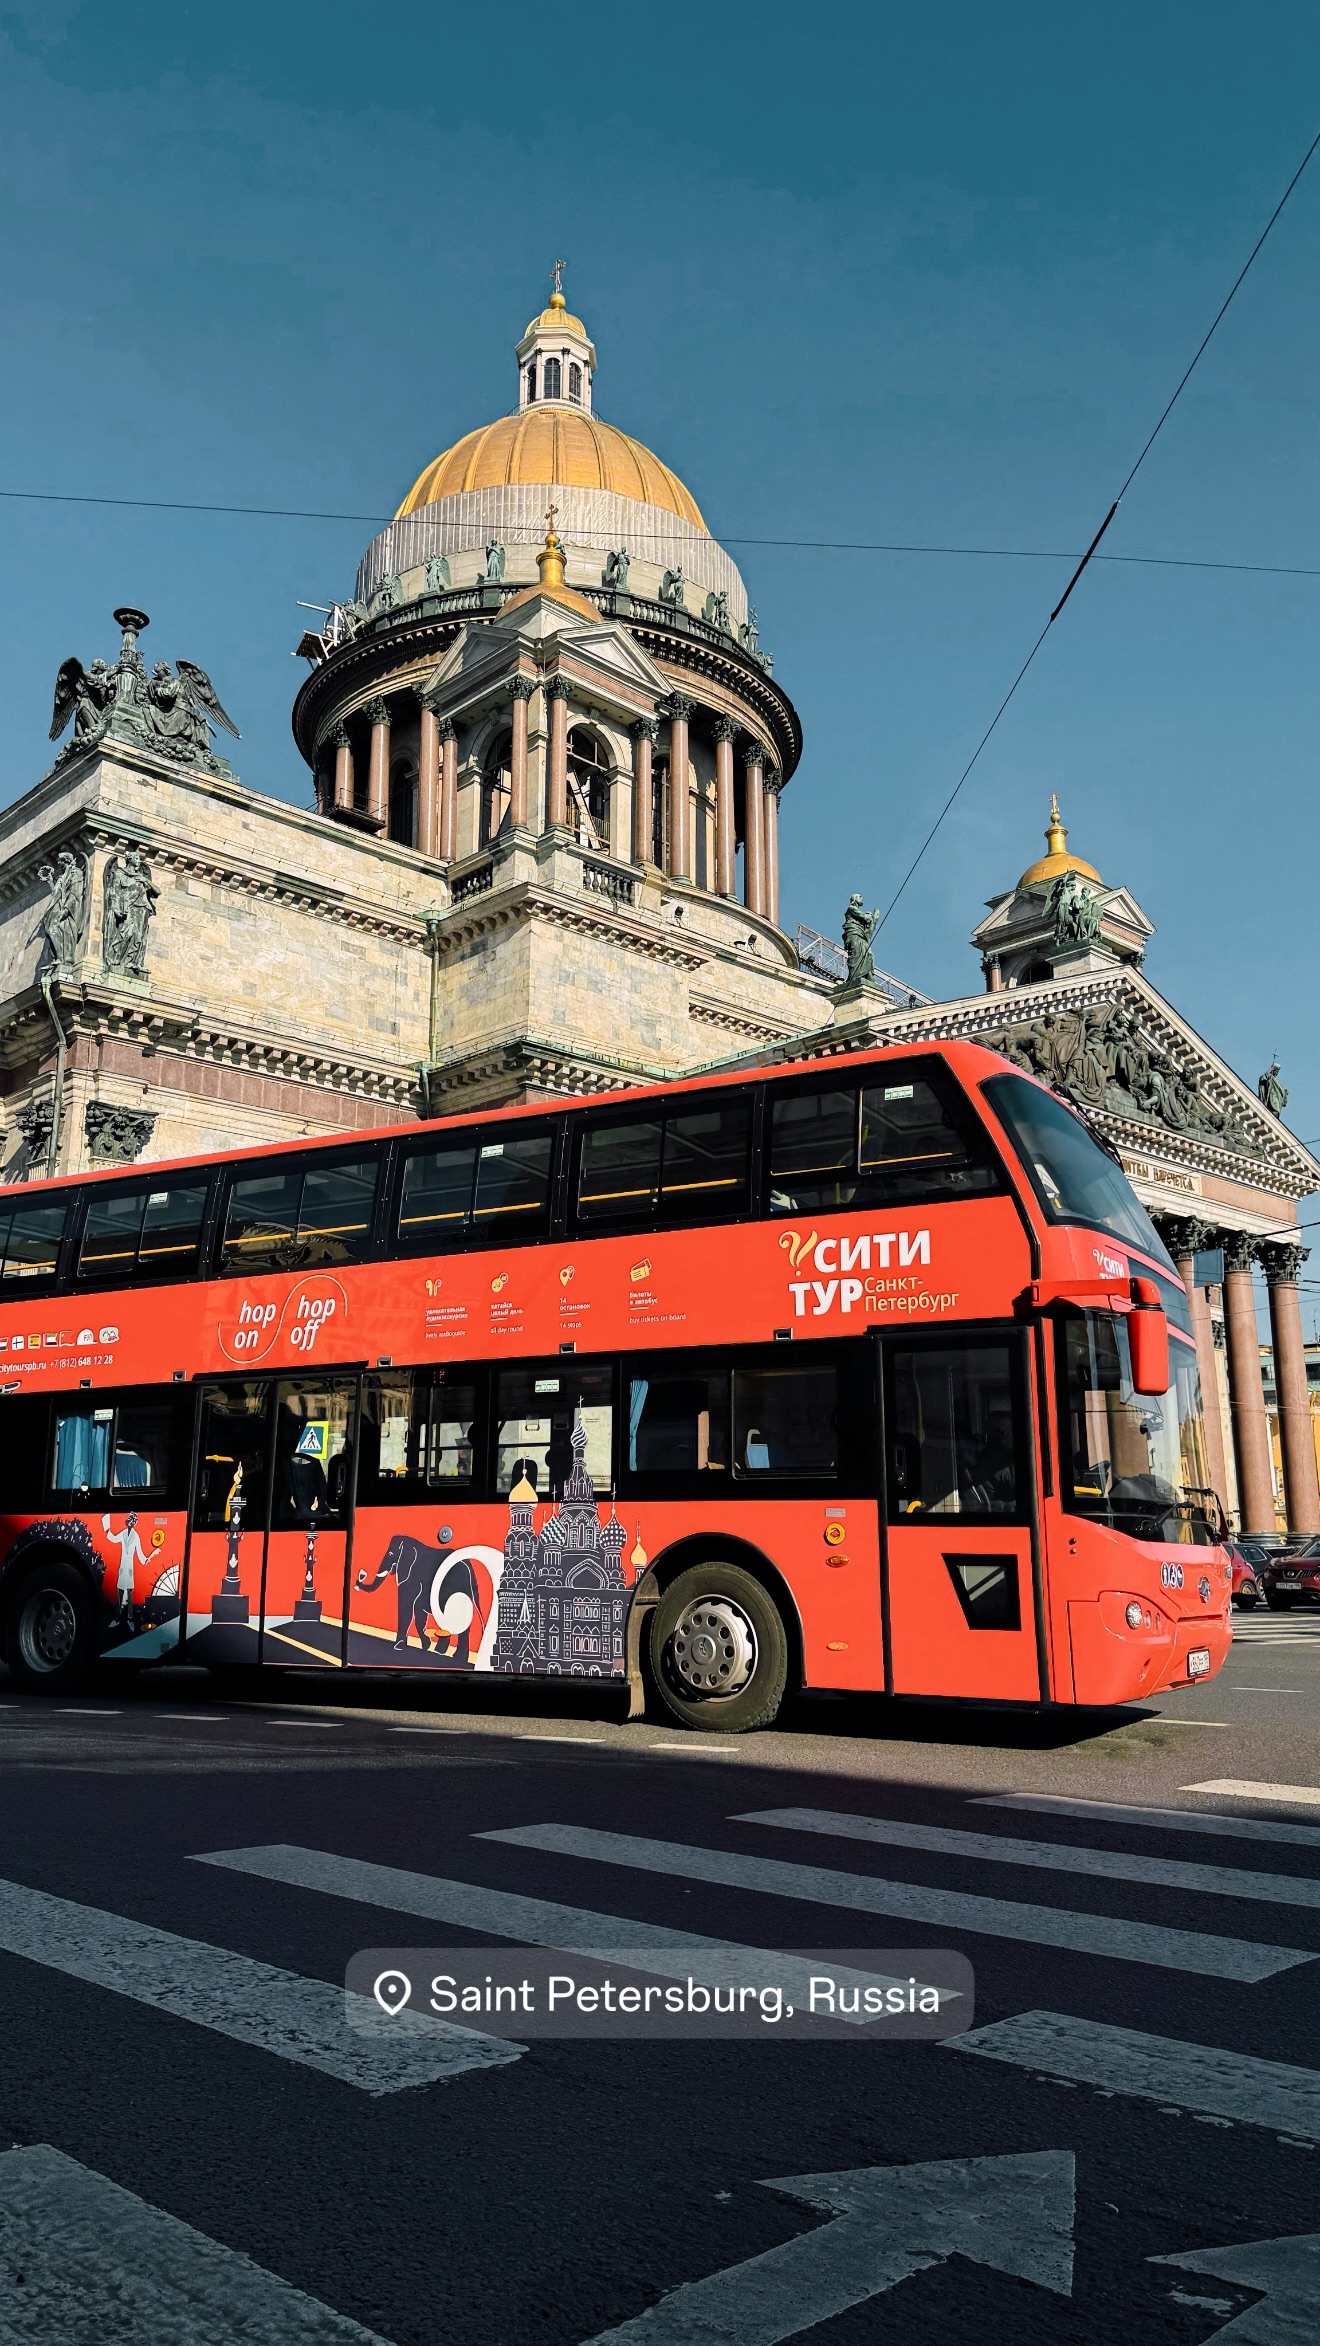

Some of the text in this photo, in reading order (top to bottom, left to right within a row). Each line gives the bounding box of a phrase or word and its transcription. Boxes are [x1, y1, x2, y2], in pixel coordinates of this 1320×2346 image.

[813, 1229, 931, 1273] СИТИ
[788, 1278, 864, 1317] ТУР
[864, 1276, 924, 1293] Санкт-
[239, 1300, 277, 1329] hop
[297, 1294, 336, 1324] hop
[864, 1290, 960, 1315] Петербург
[234, 1329, 259, 1349] on
[290, 1318, 322, 1351] off
[49, 1359, 59, 1368] +7
[59, 1357, 77, 1369] (812)
[78, 1356, 91, 1366] 648
[93, 1355, 102, 1365] 12
[103, 1354, 113, 1364] 28
